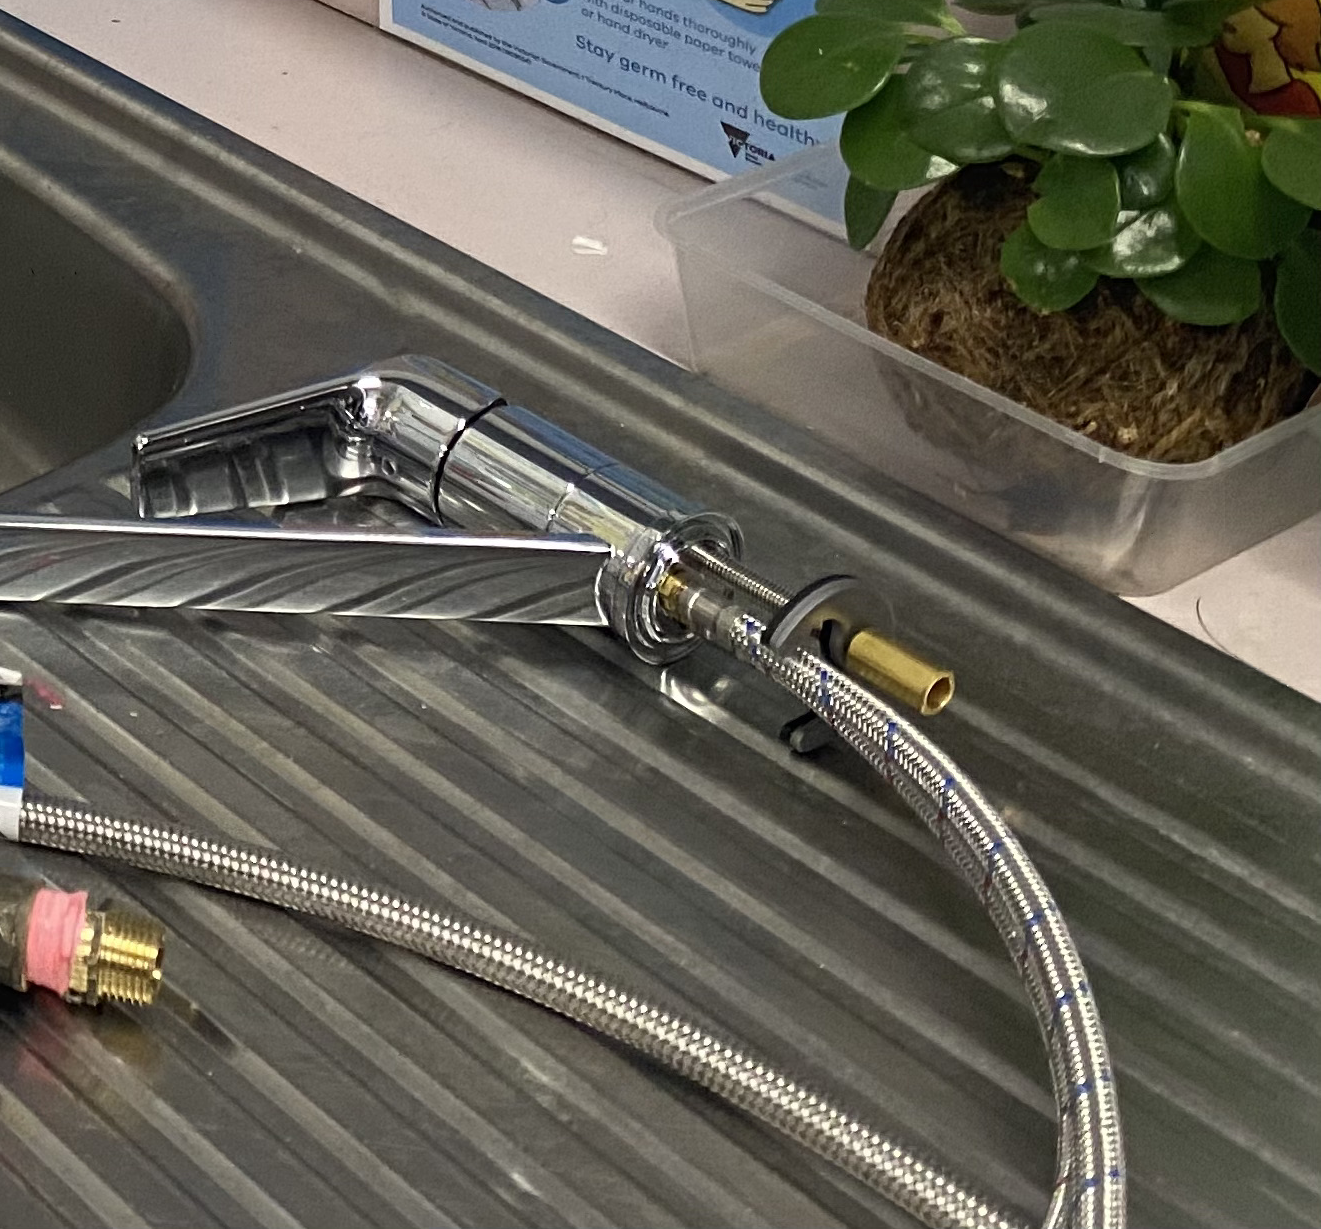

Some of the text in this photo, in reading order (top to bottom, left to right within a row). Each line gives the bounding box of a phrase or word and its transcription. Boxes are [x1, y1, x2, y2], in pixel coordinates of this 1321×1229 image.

[582, 9, 594, 18] or
[598, 14, 630, 35] hand
[611, 3, 681, 40] disposable
[685, 34, 725, 56] paper
[683, 16, 756, 55] thoroughly
[576, 34, 615, 63] Stay
[620, 56, 667, 84] germ
[672, 74, 707, 102] free
[712, 94, 749, 119] and
